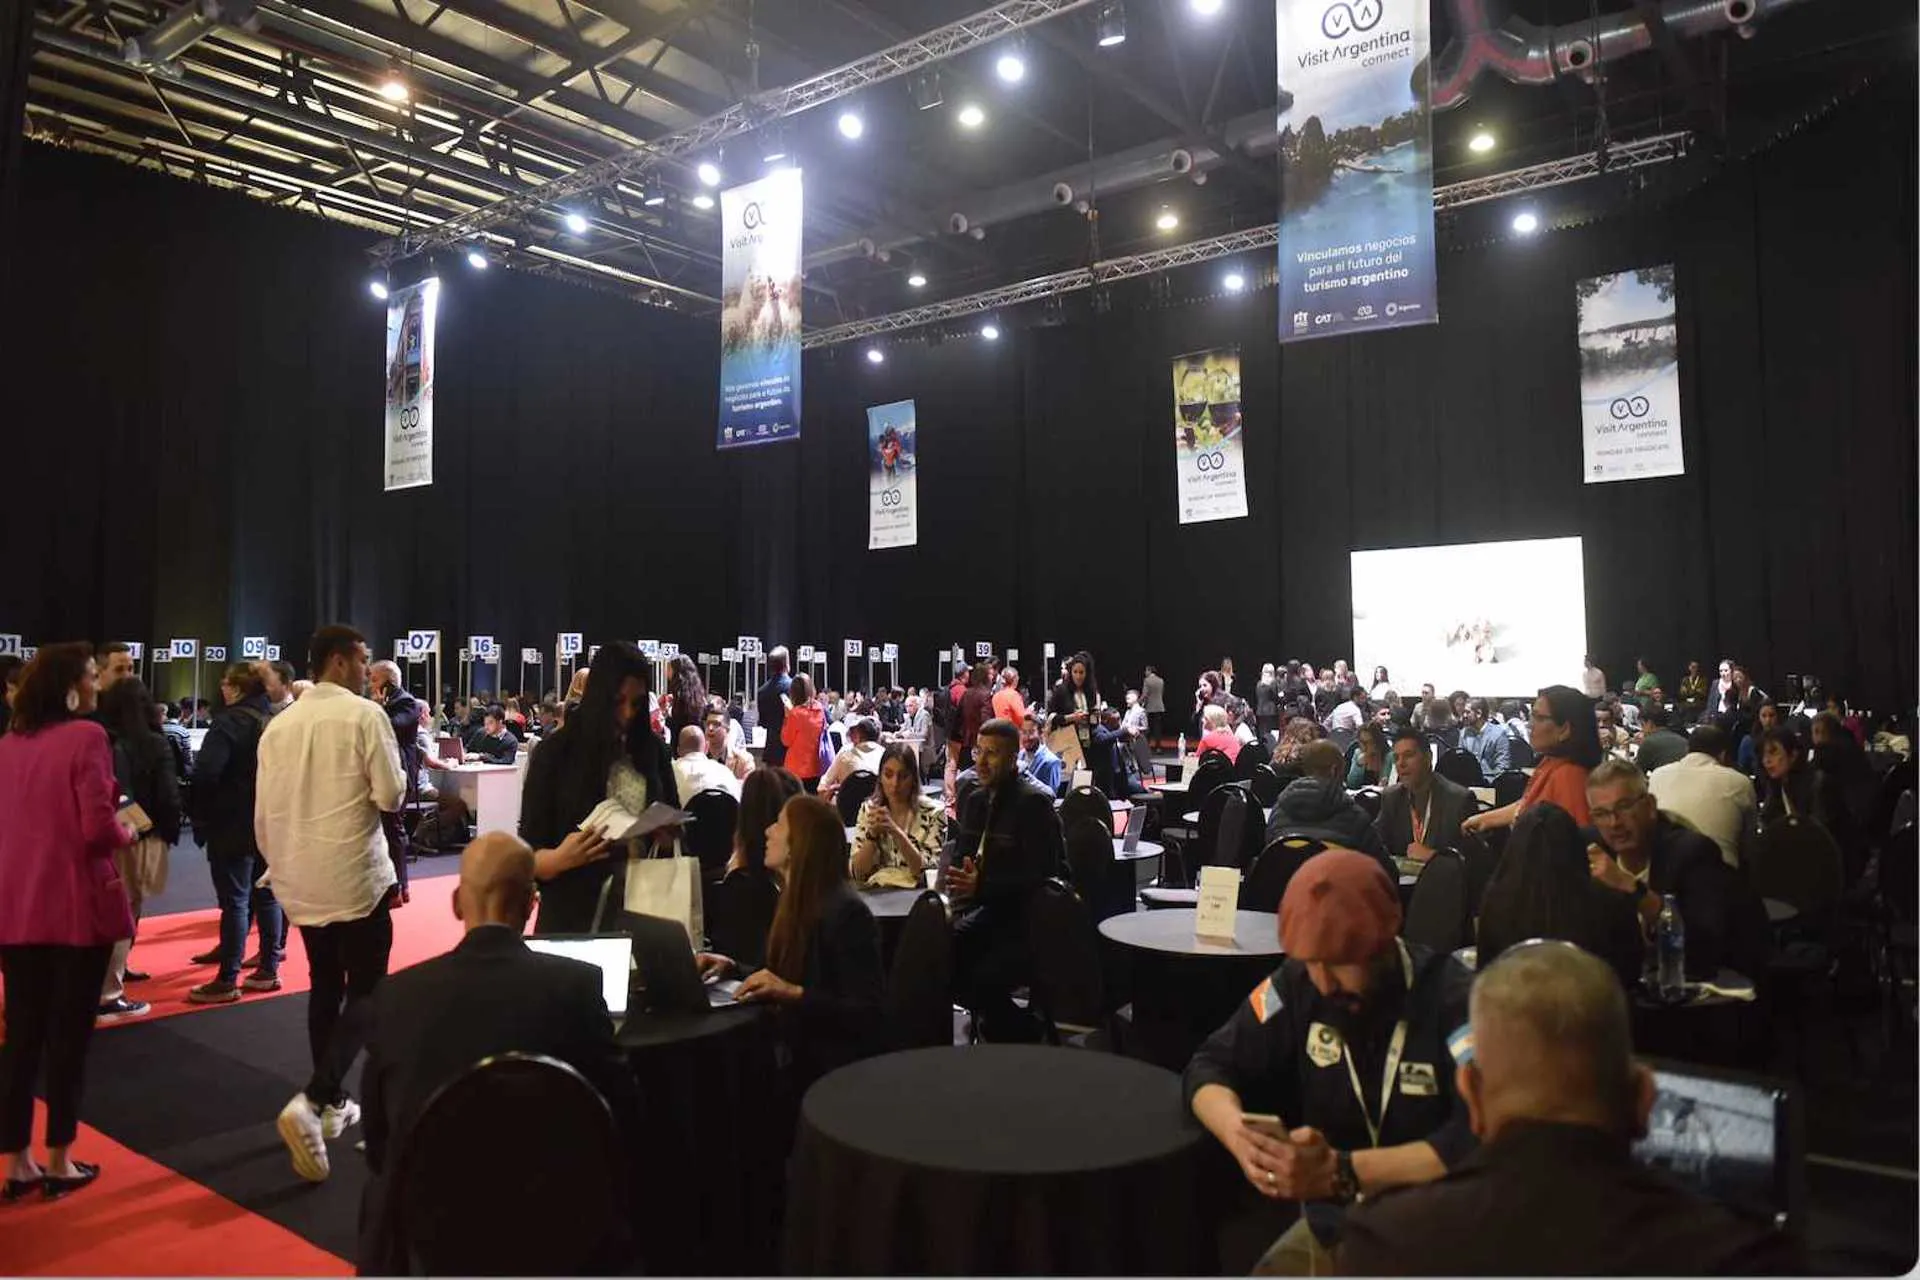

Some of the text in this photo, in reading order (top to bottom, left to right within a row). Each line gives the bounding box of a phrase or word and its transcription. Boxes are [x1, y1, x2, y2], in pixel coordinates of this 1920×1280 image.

[1297, 30, 1410, 69] Visit Argentina
[1361, 47, 1409, 68] connect
[1297, 235, 1416, 264] Vinculamos negocios
[1308, 264, 1333, 279] para
[1347, 255, 1383, 271] futuro
[1303, 267, 1409, 293] turismo argentino
[1617, 418, 1668, 433] Argentina
[173, 642, 193, 655] 10
[245, 640, 264, 653] 09
[411, 634, 436, 650] 07
[474, 639, 491, 652] 16
[563, 636, 579, 651] 15
[740, 640, 755, 652] 23
[979, 644, 990, 655] 39
[207, 649, 224, 659] 20
